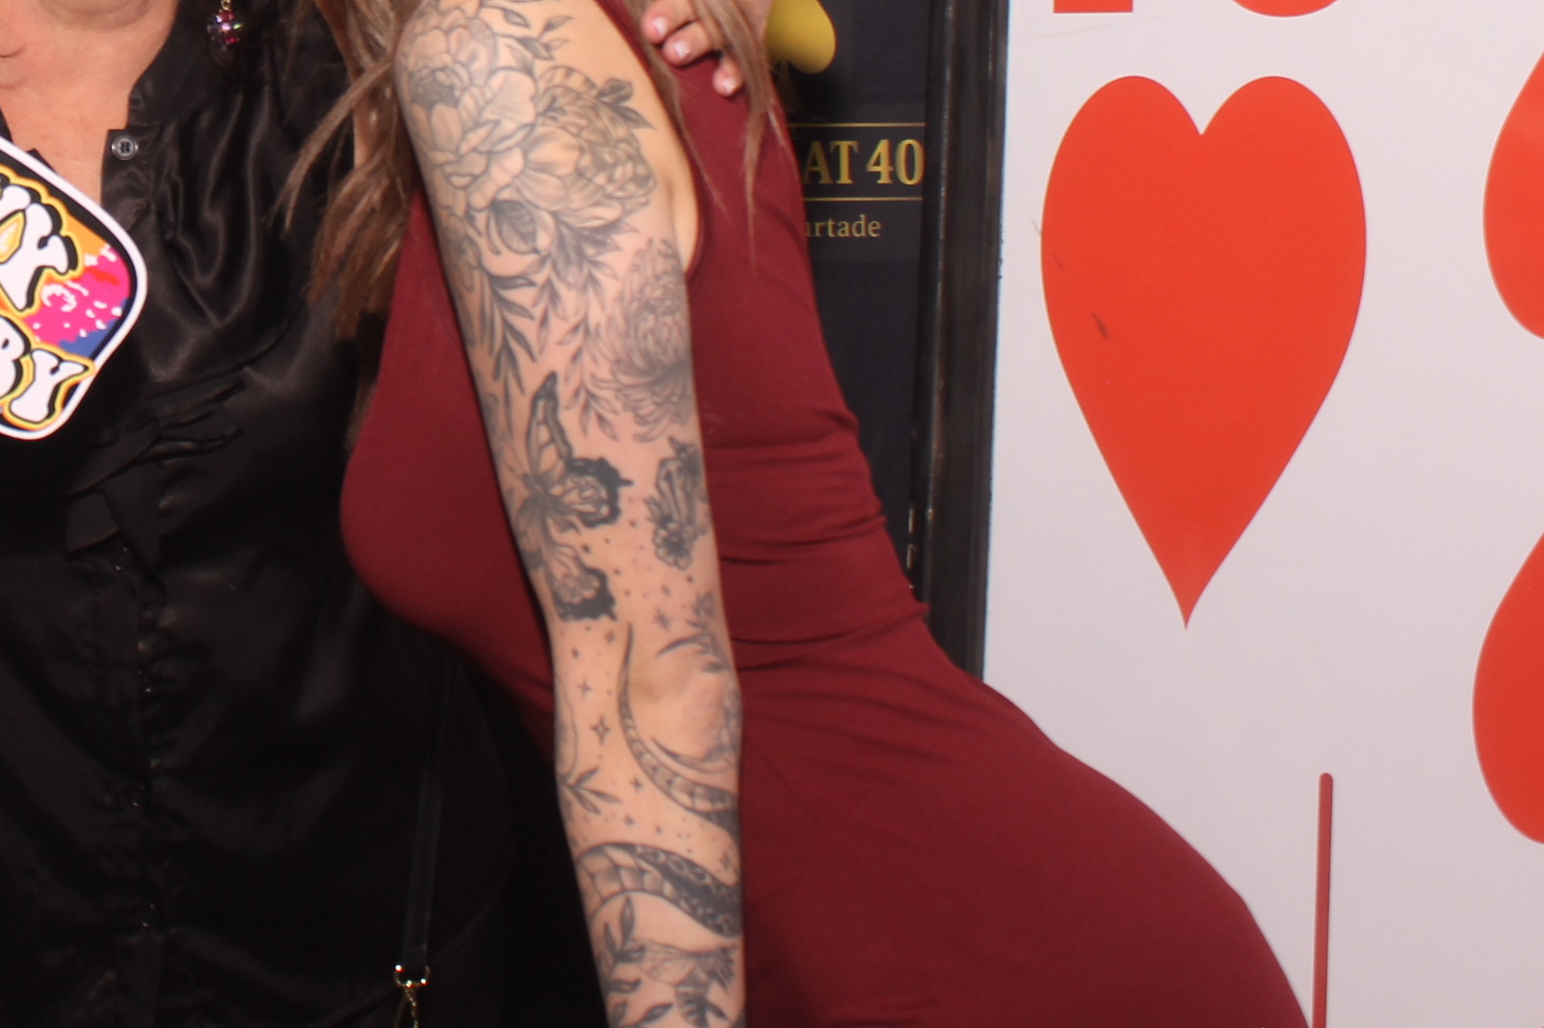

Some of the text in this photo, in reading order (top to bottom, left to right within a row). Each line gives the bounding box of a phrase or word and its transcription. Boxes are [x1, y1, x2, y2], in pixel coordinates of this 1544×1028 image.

[803, 138, 923, 186] AT 40
[807, 213, 882, 239] rtade
